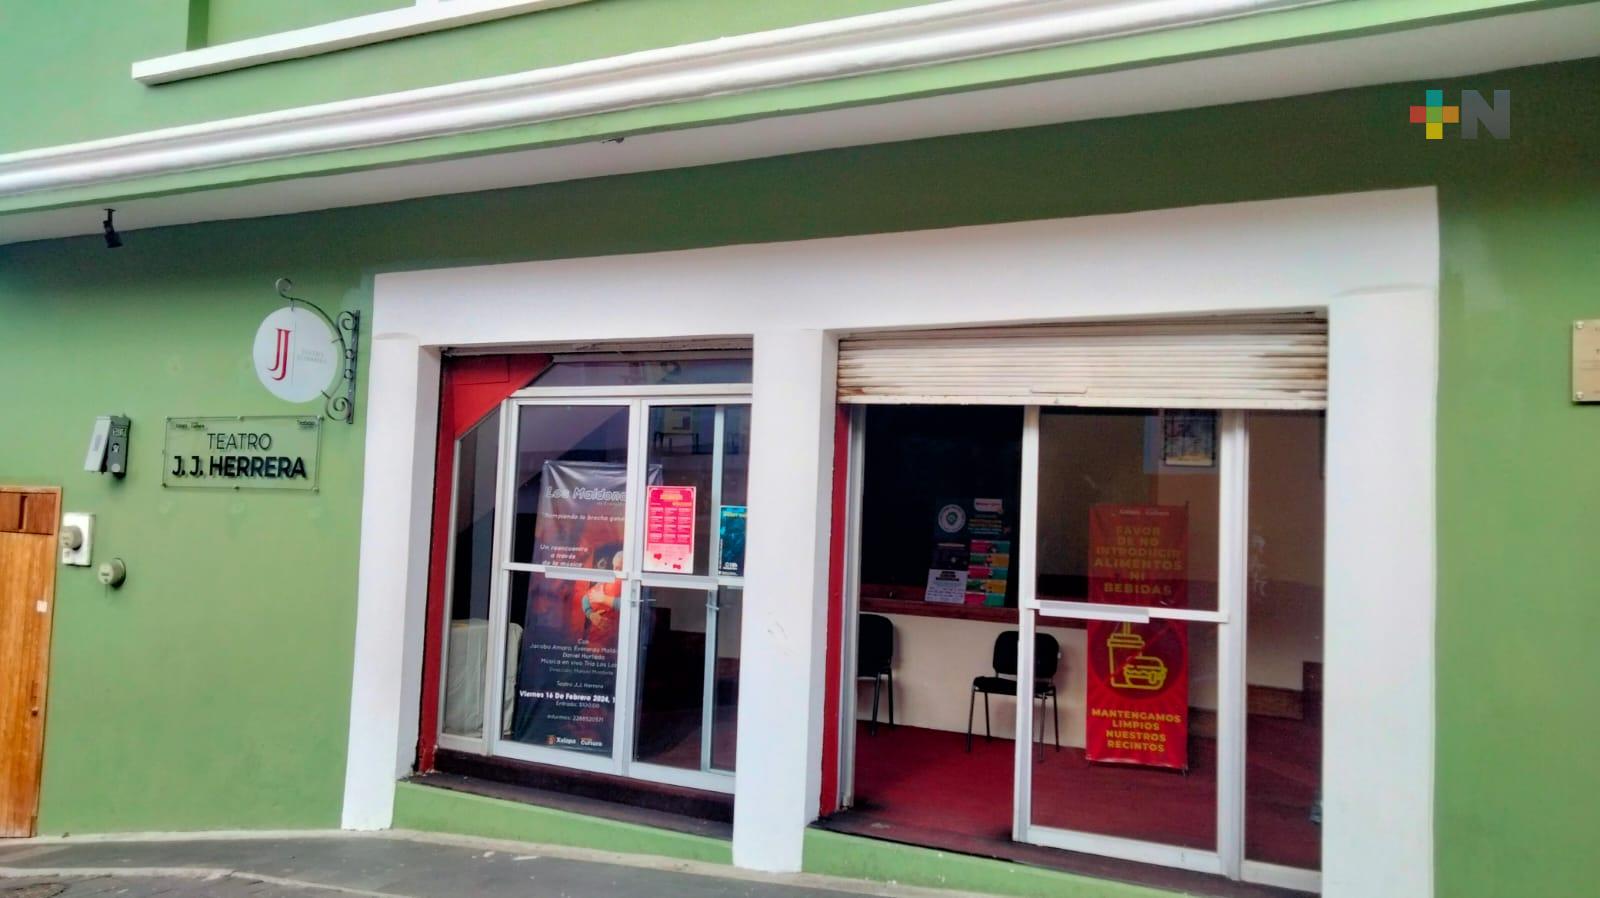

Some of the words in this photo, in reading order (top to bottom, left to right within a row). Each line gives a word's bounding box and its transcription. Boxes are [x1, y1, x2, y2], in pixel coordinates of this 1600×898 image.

[207, 433, 272, 450] TEATRO
[209, 456, 307, 479] HERRERA
[546, 487, 570, 499] Los
[1116, 527, 1160, 537] FAVOR
[1118, 536, 1134, 546] DE
[1140, 537, 1159, 547] NO
[1094, 559, 1184, 570] ALIMENTOS
[1130, 571, 1145, 581] NI
[1103, 583, 1172, 595] BEBIDAS
[519, 690, 544, 699] Viernes
[545, 691, 554, 700] 16
[554, 691, 565, 700] De
[565, 692, 591, 702] Febrero
[1091, 708, 1182, 723] MANTENGAMOS
[1112, 720, 1160, 731] LIMPIOS
[1106, 730, 1166, 742] NUESTROS
[1107, 741, 1165, 752] RECINTOS
